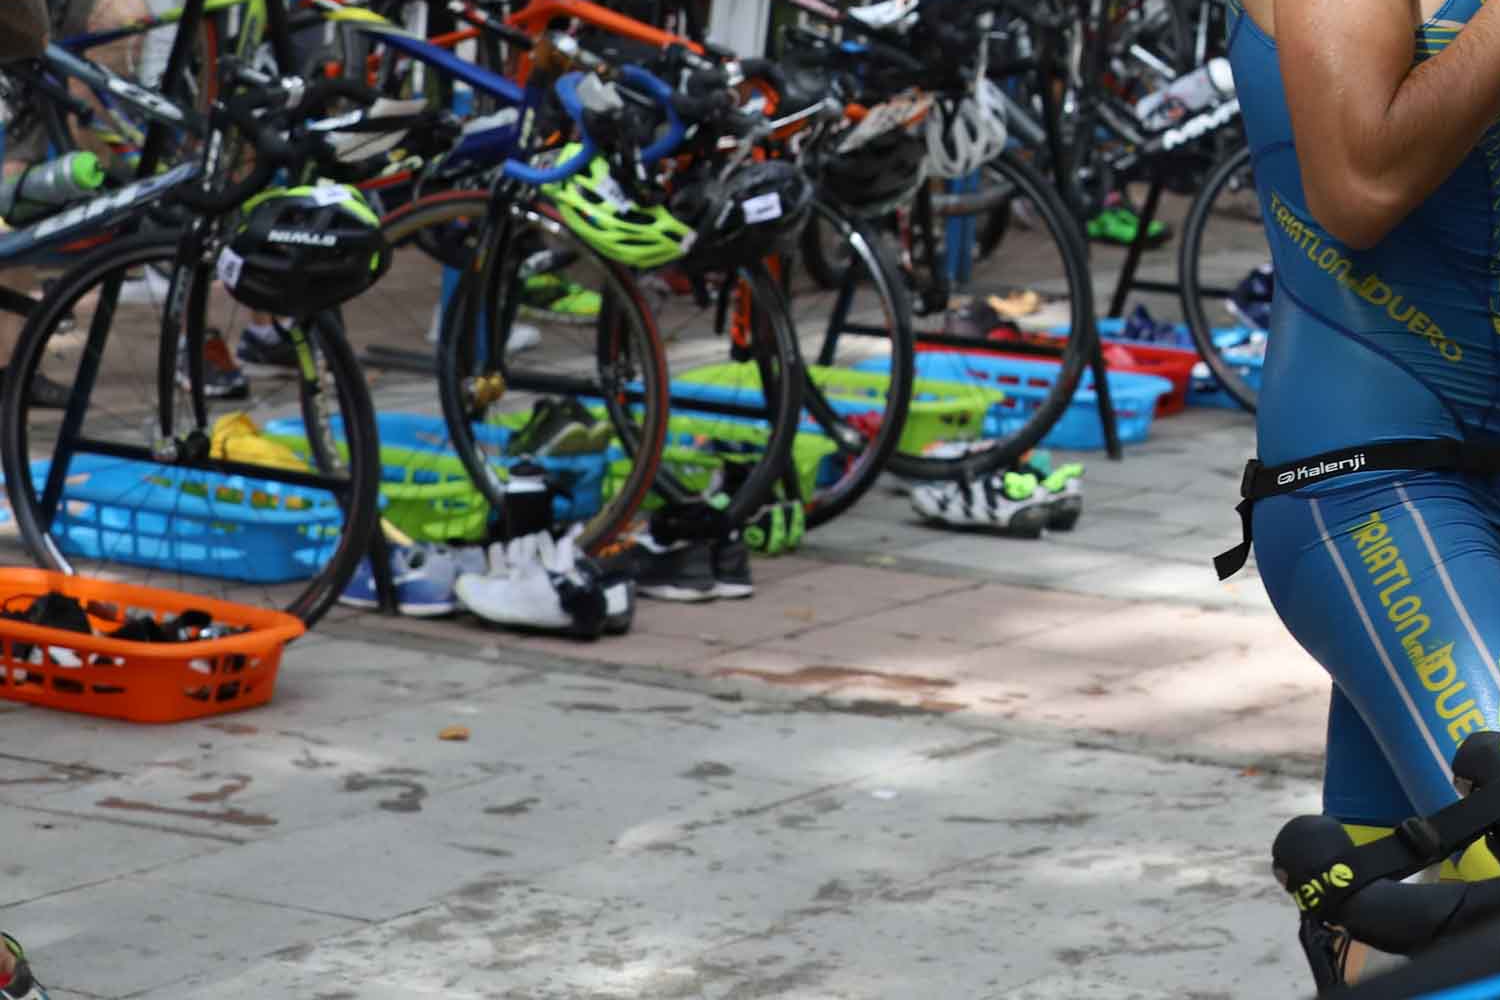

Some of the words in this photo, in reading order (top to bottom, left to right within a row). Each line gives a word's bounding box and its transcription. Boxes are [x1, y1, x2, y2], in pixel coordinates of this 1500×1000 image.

[1361, 275, 1463, 361] DUERO
[1297, 453, 1365, 480] Kalenji
[1347, 511, 1431, 650] TRIATLON
[1416, 643, 1486, 745] DUE
